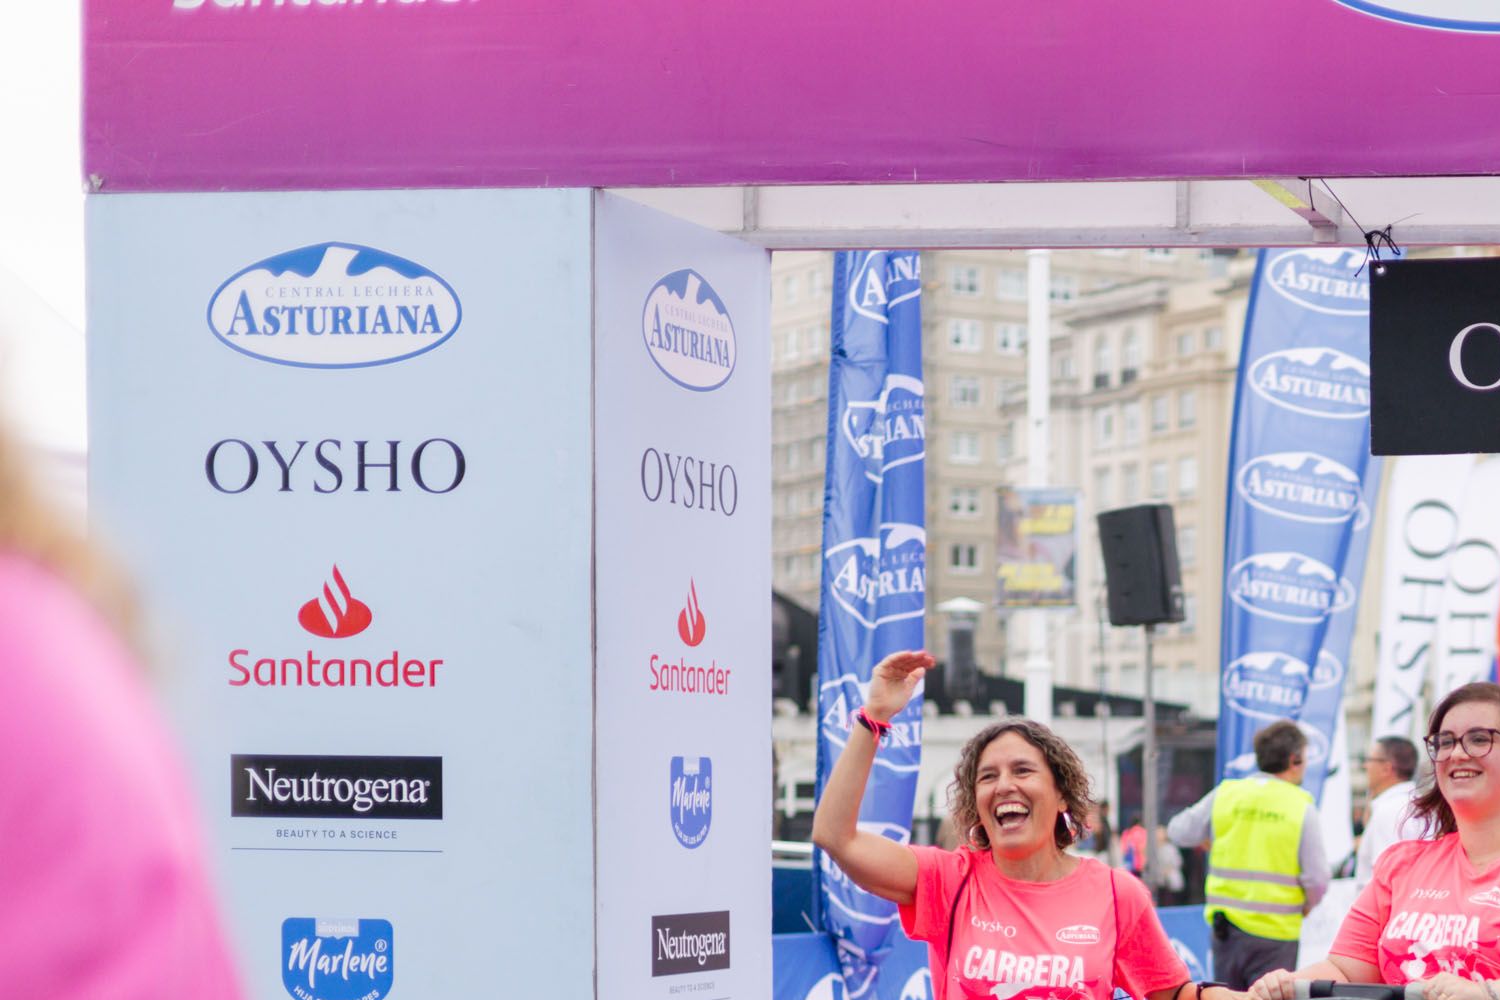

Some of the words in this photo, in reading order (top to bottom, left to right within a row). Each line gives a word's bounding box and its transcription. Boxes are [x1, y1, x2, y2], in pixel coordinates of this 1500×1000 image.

[265, 286, 345, 298] CENTRAL
[353, 284, 434, 298] LECHERA
[1277, 260, 1370, 301] ASTURIA
[226, 289, 443, 336] ASTURIANA
[650, 303, 730, 369] ASTURIANA
[1260, 363, 1370, 405] ASTURIAN
[204, 438, 467, 494] OYSHO
[641, 447, 738, 517] OYSHO
[1389, 499, 1459, 725] YSHO
[228, 648, 444, 689] Santander
[650, 654, 731, 695] Santander
[244, 767, 429, 812] Neutrogena
[276, 829, 318, 838] BEAUTY
[322, 830, 335, 839] TO
[340, 830, 346, 839] A
[350, 831, 397, 840] SCIENCE
[656, 927, 727, 966] Neutrogena
[1386, 911, 1480, 949] CARRERA
[288, 937, 388, 989] Marlene
[963, 944, 1086, 990] CARRERA
